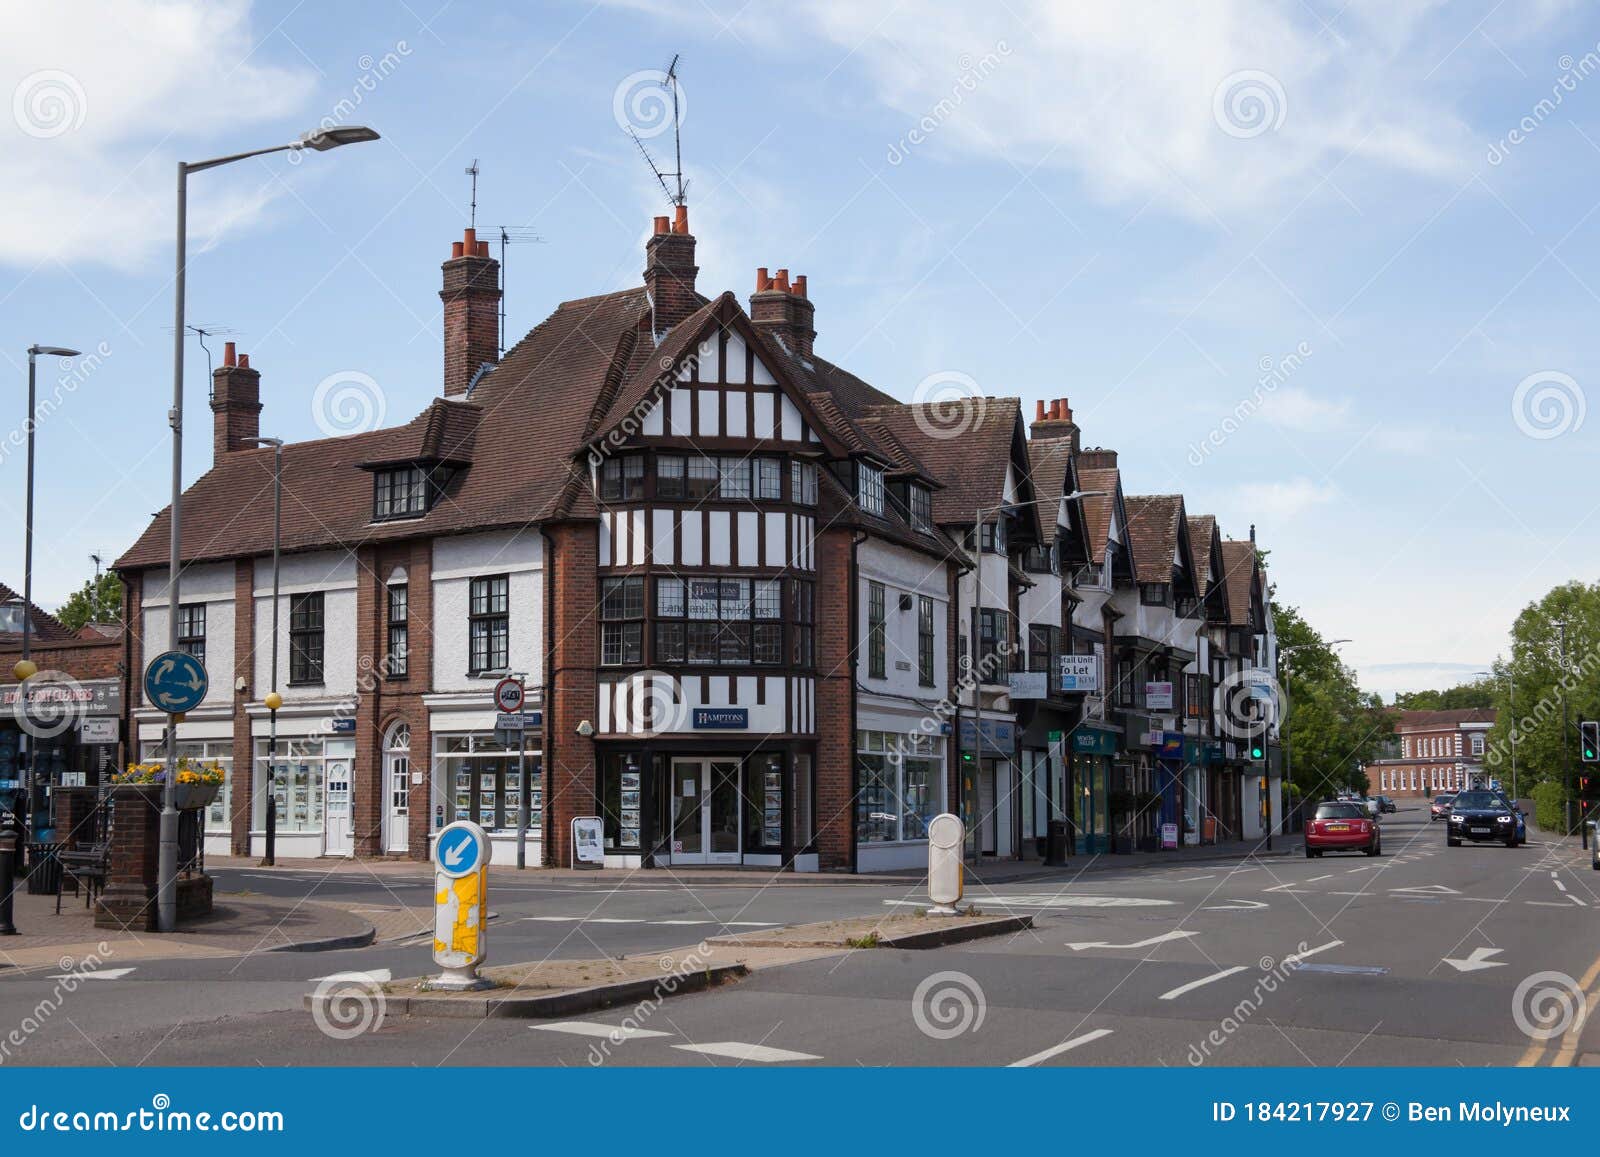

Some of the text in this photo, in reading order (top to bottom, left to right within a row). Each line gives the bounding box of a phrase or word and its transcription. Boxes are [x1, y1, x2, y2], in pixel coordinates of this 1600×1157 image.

[1078, 656, 1094, 664] Unit
[1073, 665, 1089, 675] Let
[3, 691, 34, 704] ROYE
[53, 688, 93, 702] CLEANERS
[698, 712, 744, 724] HAMPTONS
